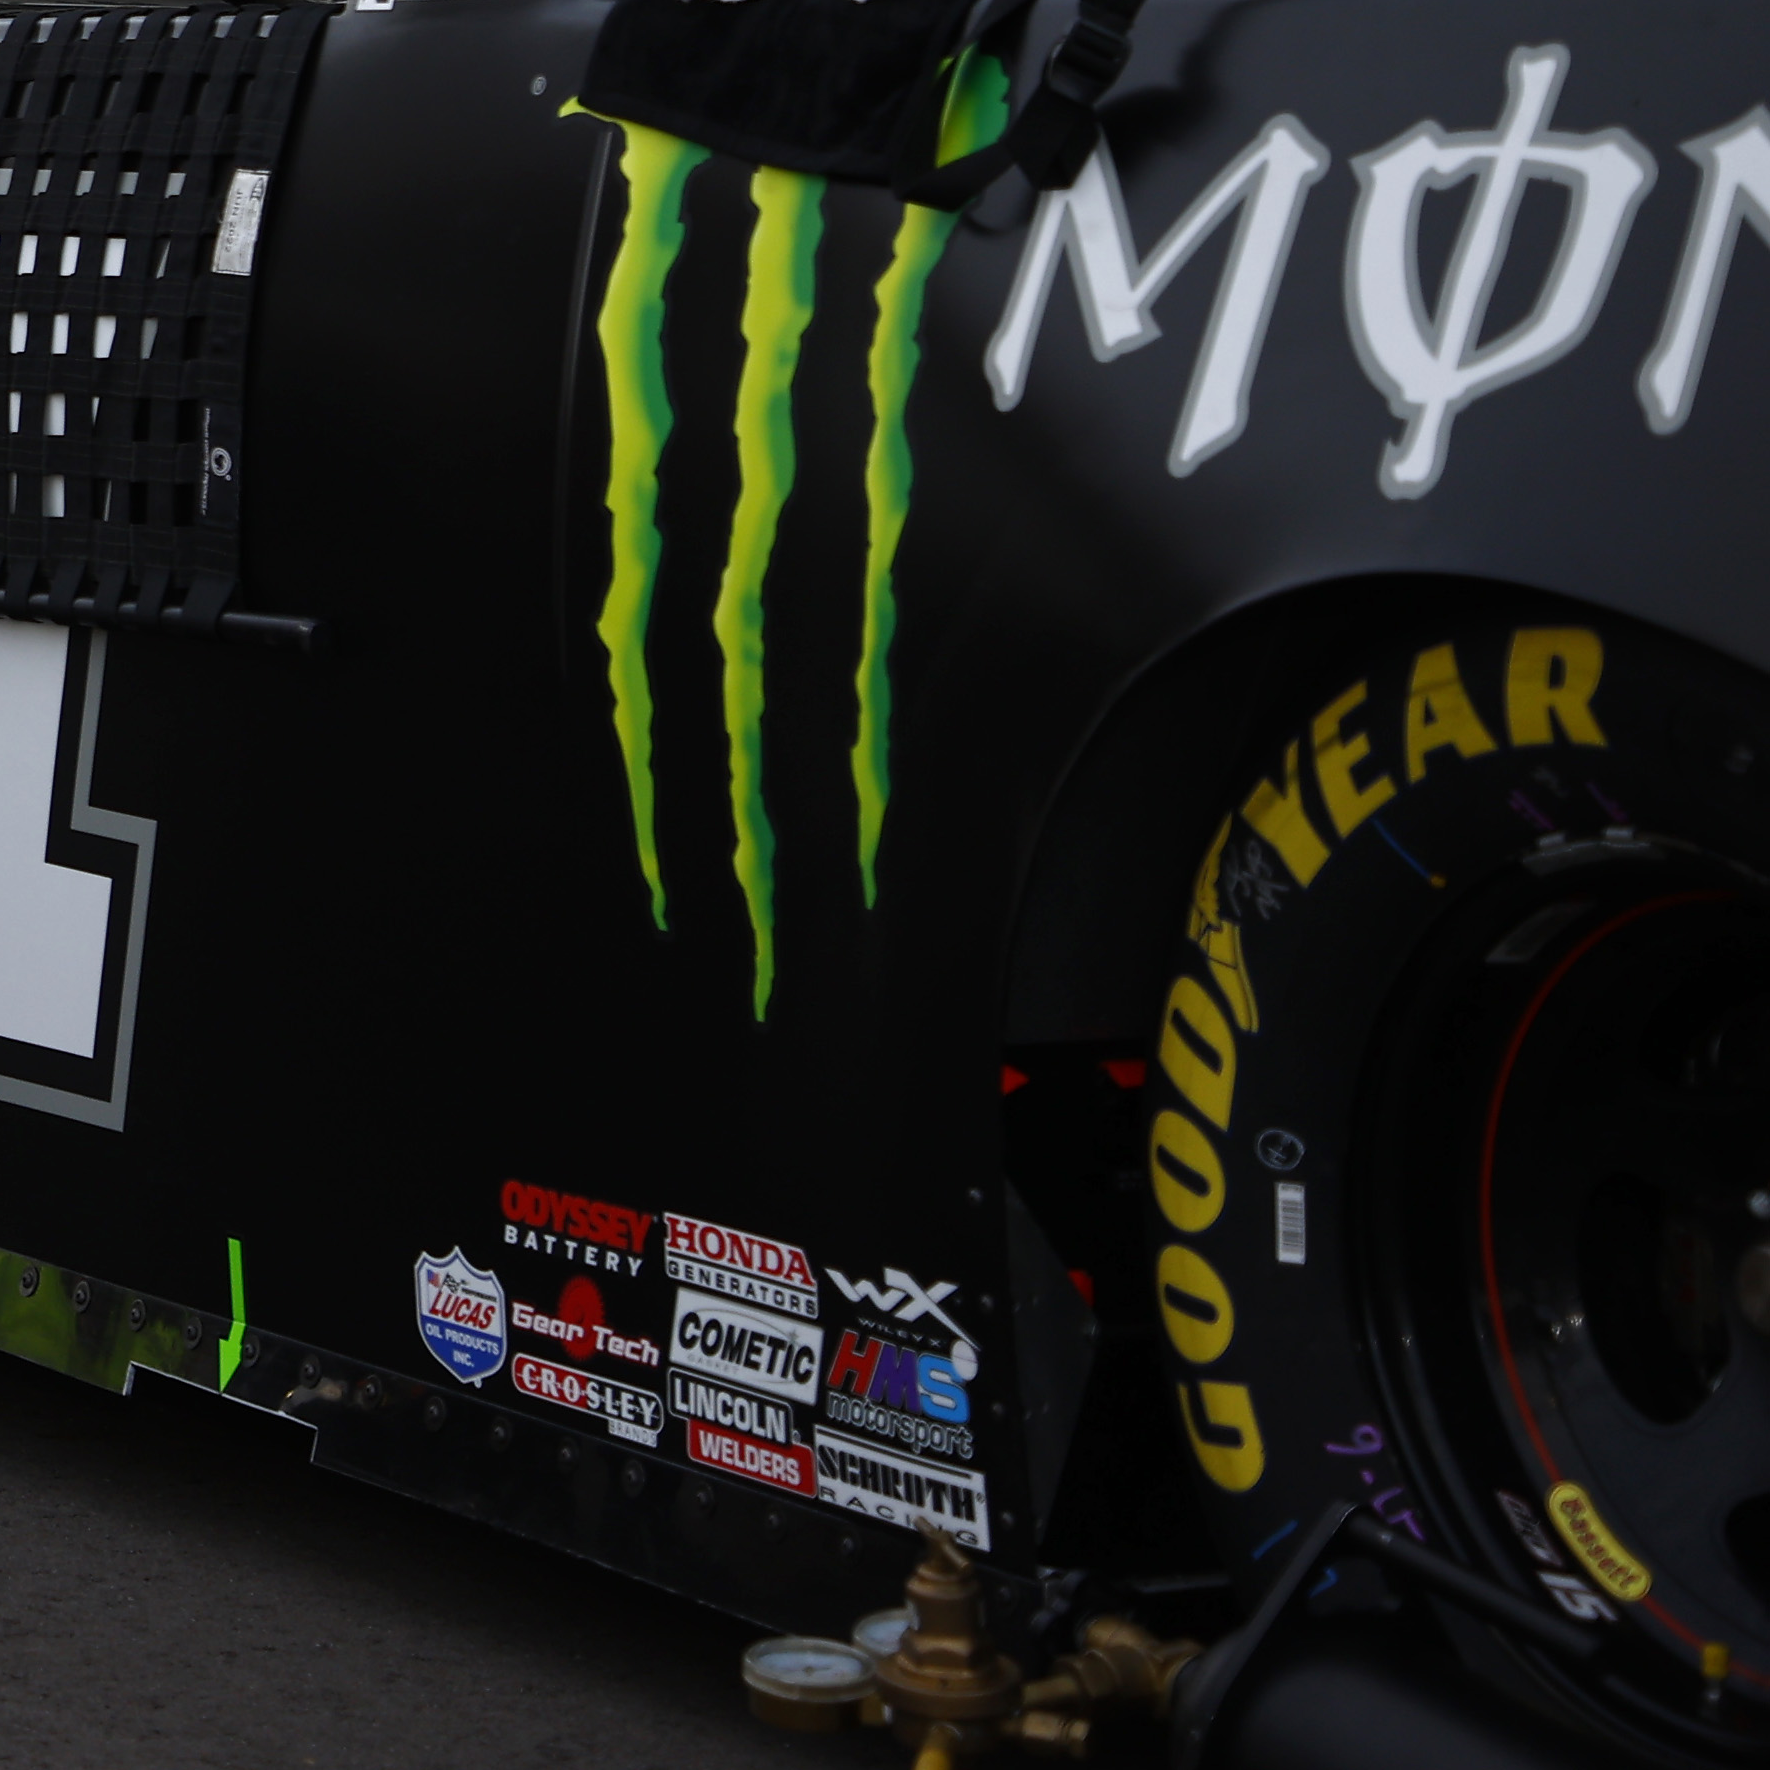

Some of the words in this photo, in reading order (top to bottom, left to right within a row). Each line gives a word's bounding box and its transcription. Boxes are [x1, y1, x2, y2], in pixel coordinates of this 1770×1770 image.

[1150, 627, 1607, 1492] GOODYEAR
[501, 1180, 653, 1253] ODYSSEY
[504, 1224, 644, 1278] BATTERY
[664, 1216, 814, 1287] HONDA
[428, 1291, 496, 1330] LUCAS
[667, 1260, 817, 1317] GENERATORS
[425, 1322, 444, 1339] OIL
[444, 1327, 500, 1356] PRODUCTS
[452, 1349, 475, 1368] INC.
[511, 1302, 585, 1342] Gear
[591, 1324, 660, 1367] Tech
[678, 1312, 816, 1385] COMETIC
[519, 1362, 658, 1426] CROSLEY
[826, 1328, 970, 1425] HMS
[674, 1377, 788, 1444] LINCOLN
[828, 1393, 975, 1460] motorsport
[698, 1430, 802, 1486] WELDERS
[817, 1443, 977, 1523] SCHROTH
[1560, 1498, 1637, 1589] Bassett
